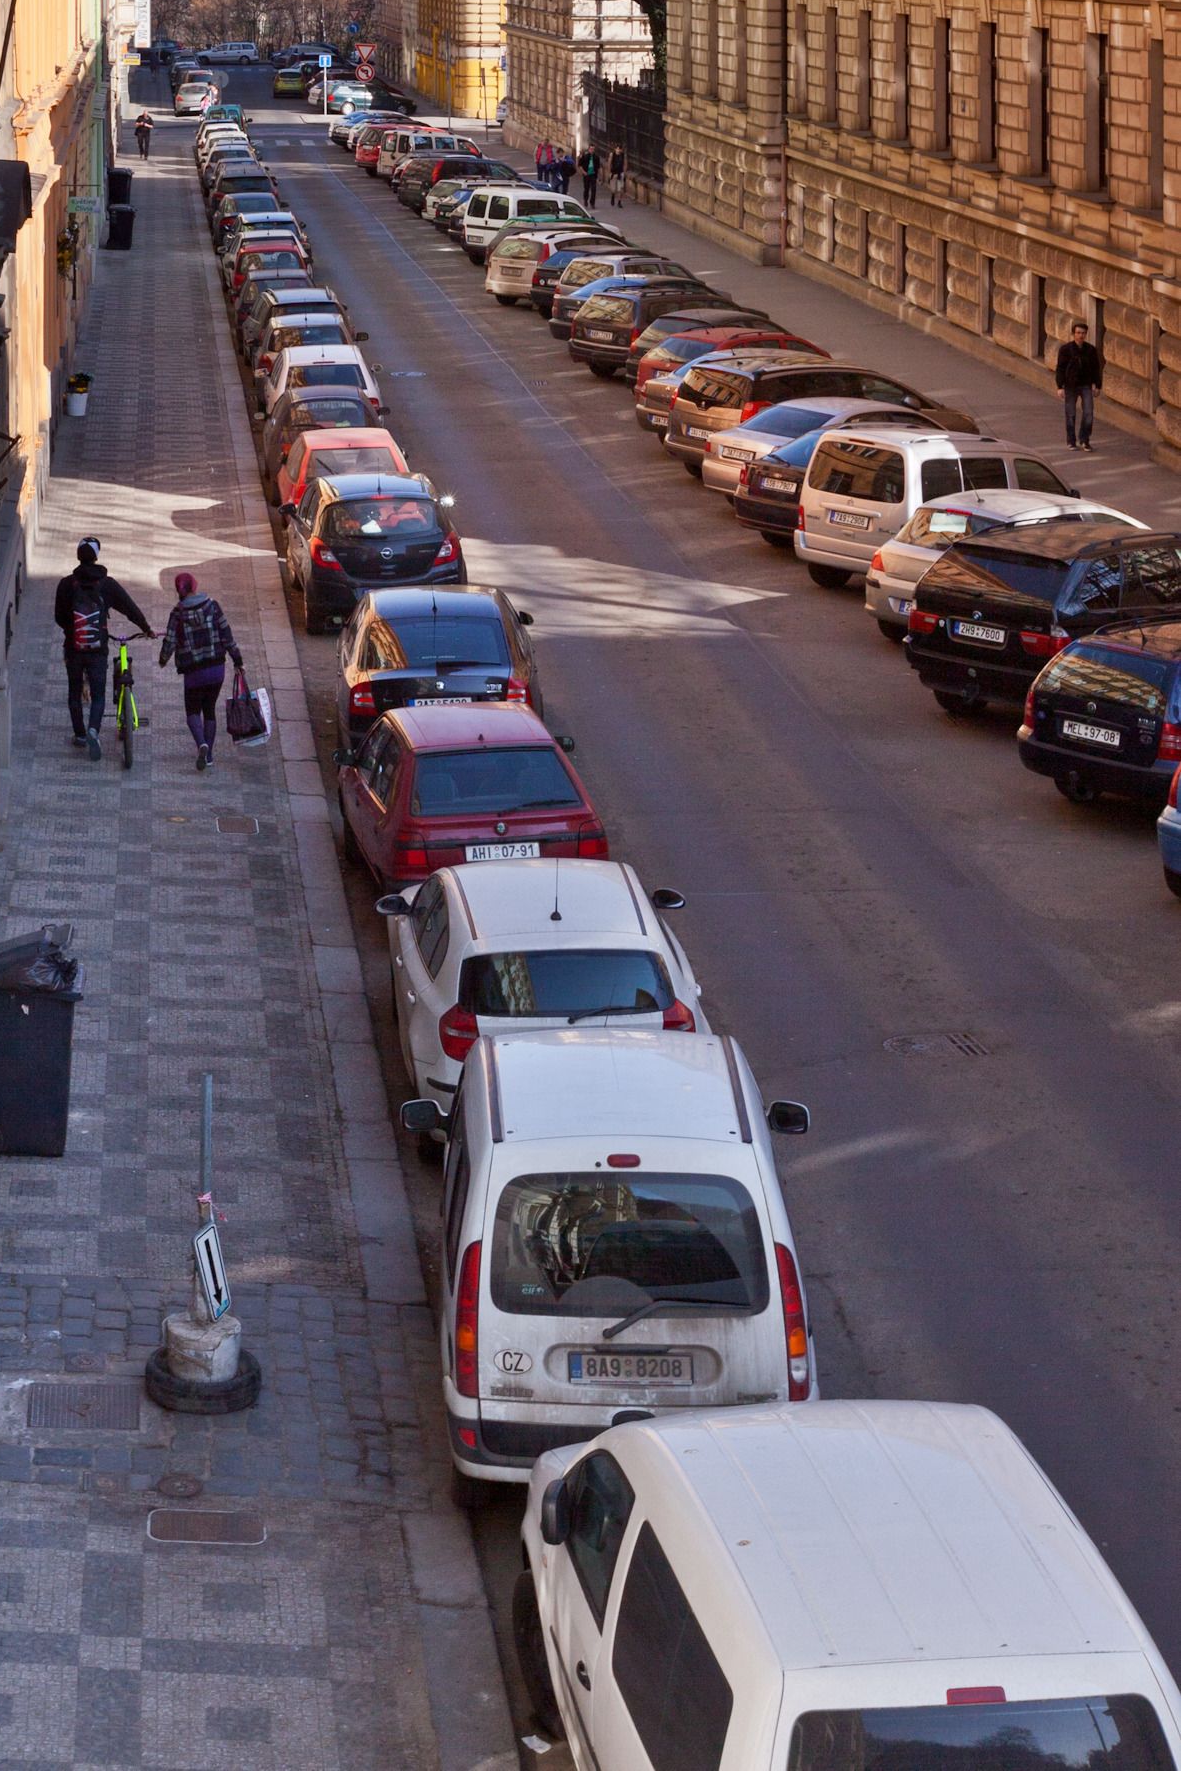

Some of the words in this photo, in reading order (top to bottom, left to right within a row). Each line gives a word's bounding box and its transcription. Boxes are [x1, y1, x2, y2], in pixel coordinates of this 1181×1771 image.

[961, 623, 976, 636] 2H9
[980, 627, 1000, 641] 7600
[1067, 722, 1082, 736] MEL
[1090, 726, 1116, 743] 97-08
[501, 844, 534, 857] 07-91
[502, 1351, 525, 1373] CZ
[586, 1358, 620, 1377] 8A9
[636, 1358, 682, 1378] 8208
